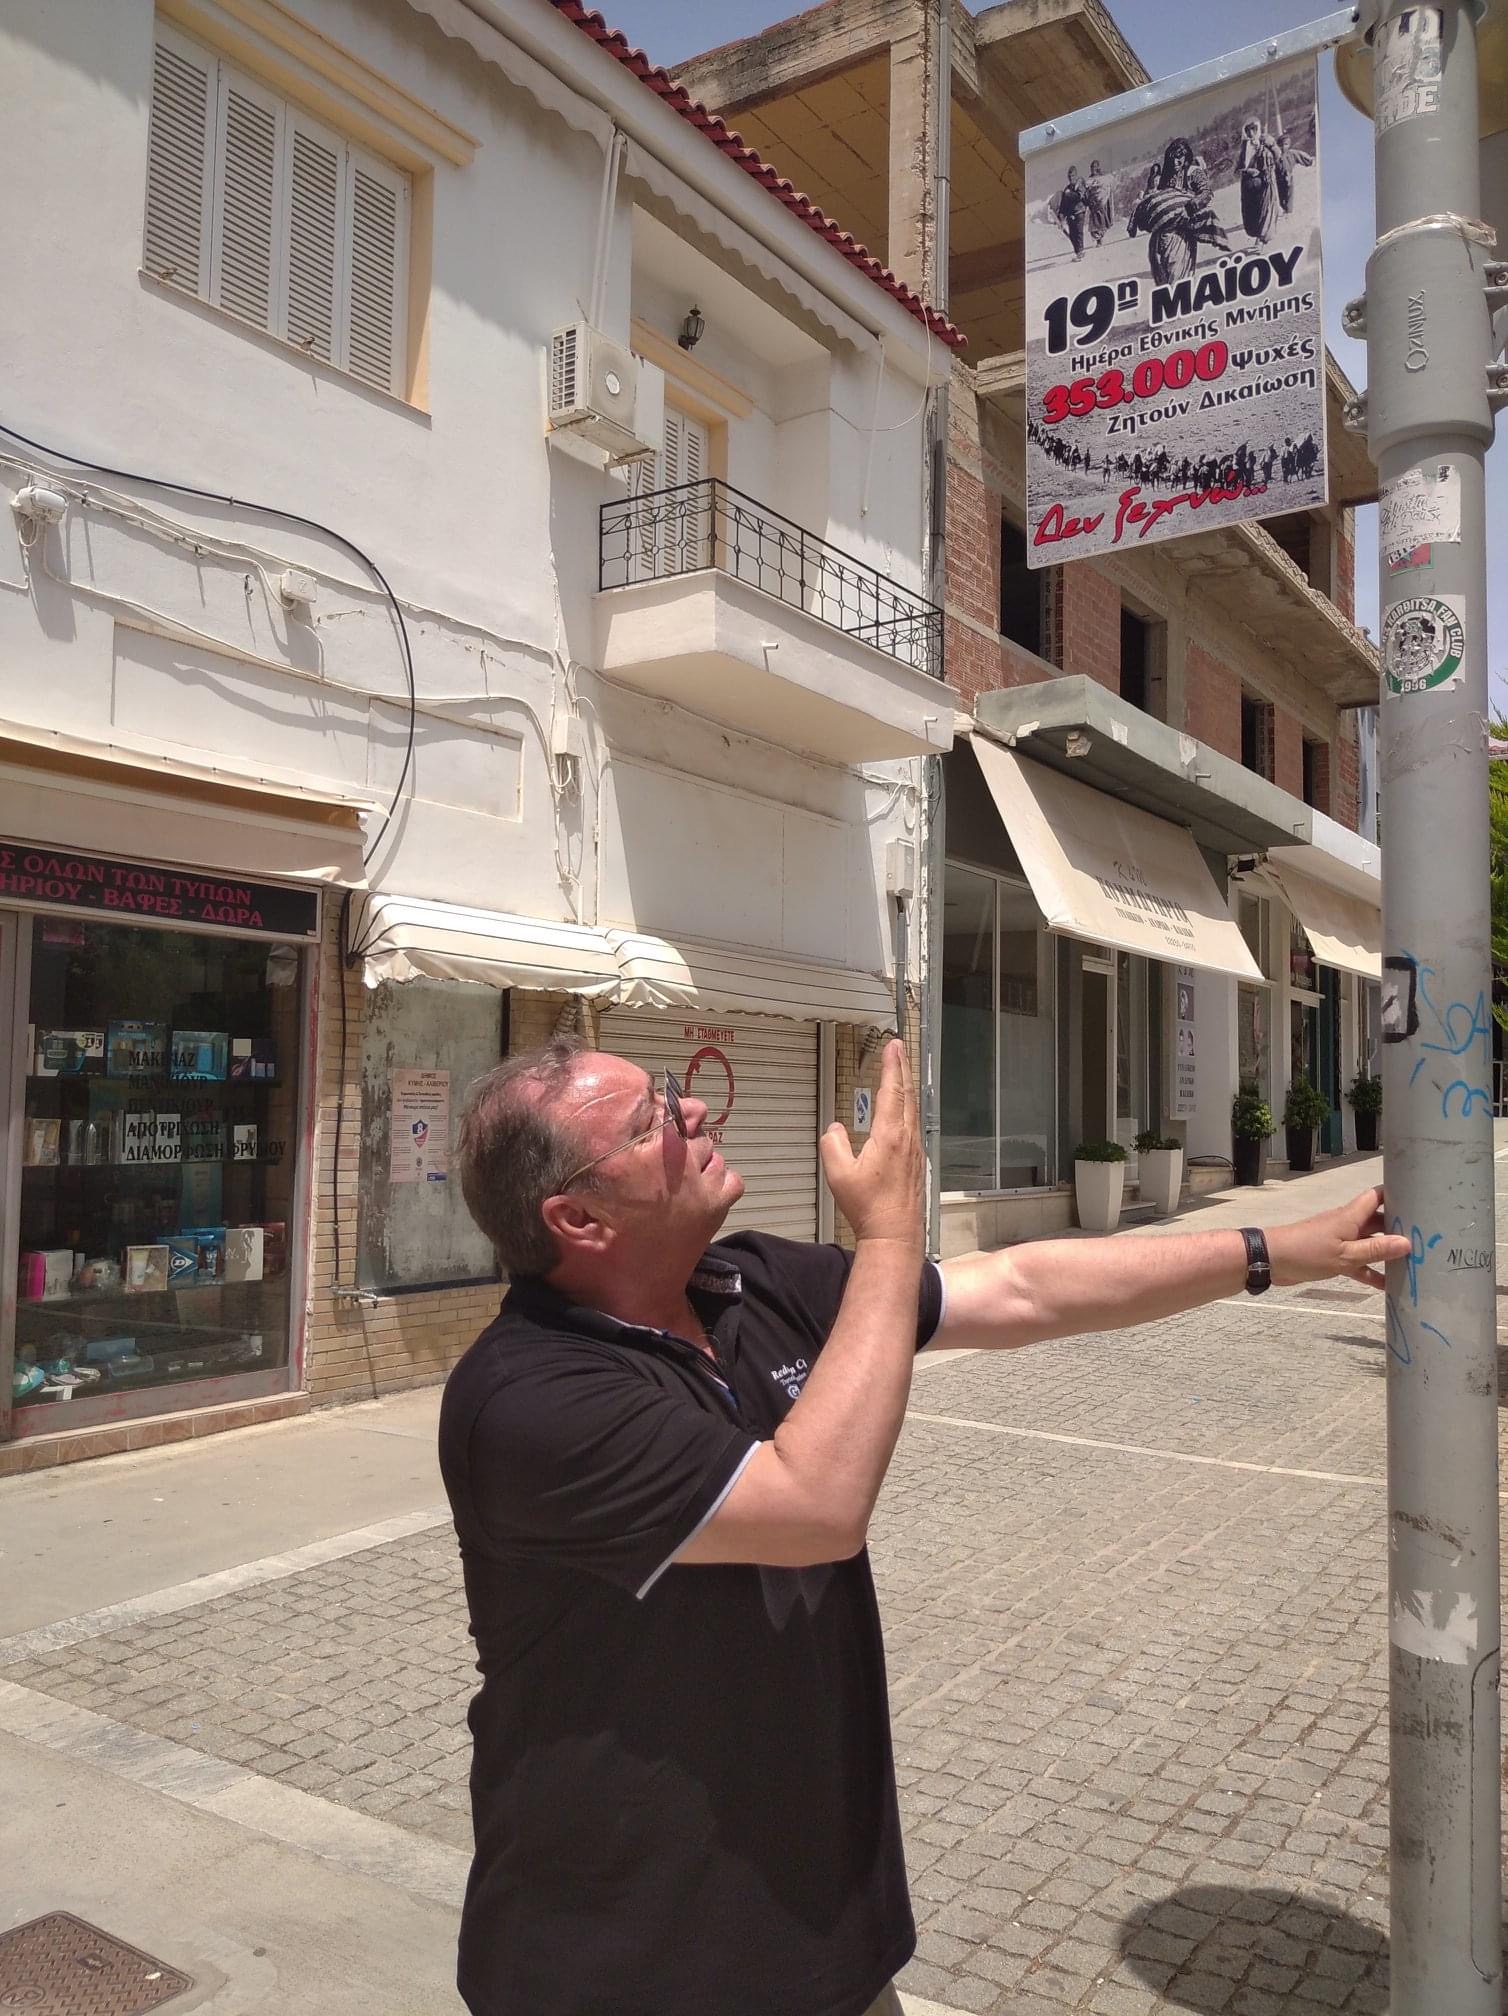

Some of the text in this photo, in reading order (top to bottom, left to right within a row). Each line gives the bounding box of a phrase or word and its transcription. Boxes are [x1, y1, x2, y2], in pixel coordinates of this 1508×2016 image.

[1044, 246, 1303, 354] 19η ΜΑΪΟΥ
[1071, 293, 1314, 373] Ημέρα Εθνικής Μνήμης
[1042, 340, 1228, 424] 353.000
[1107, 368, 1316, 435] Ζητούν Δικαίωση
[1034, 503, 1105, 547] Δεν
[1437, 606, 1457, 627] FAN
[1450, 627, 1465, 658] CLUB
[24, 855, 104, 883] ΟΛΩΝ
[112, 868, 165, 893] ΤΩΝ
[171, 878, 252, 905] ΤΥΠΩΝ
[104, 888, 182, 916] ΒΑΦΕΣ
[201, 903, 264, 927] ΔΩΡΑ
[128, 1051, 196, 1067] ΜΑΚΙΙΑΖ
[684, 1026, 735, 1042] ΜΗ ΣΤΑΘΜΕΥΕΤΕ
